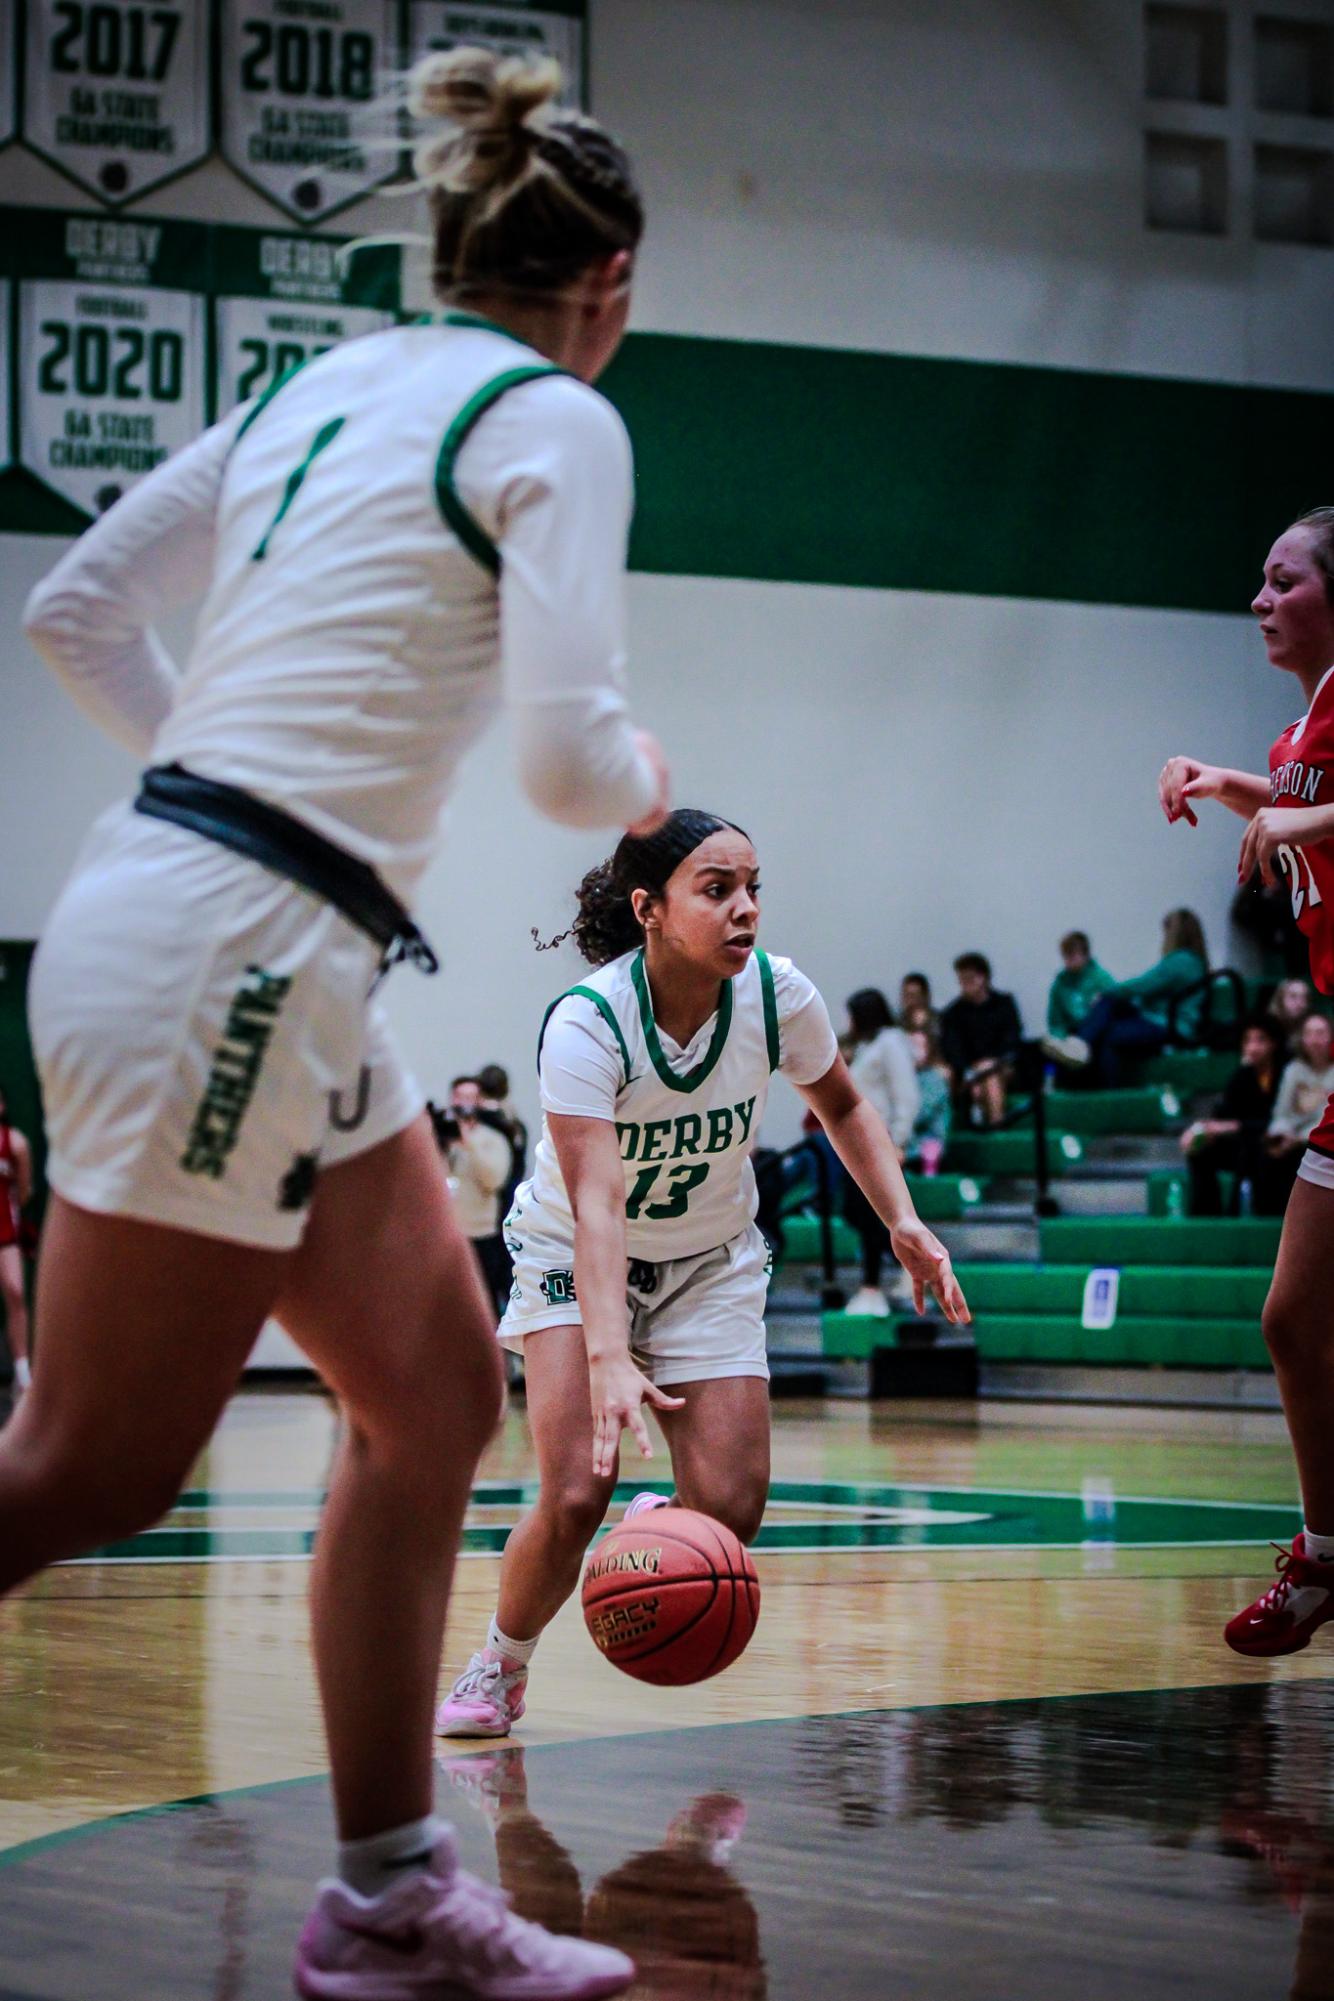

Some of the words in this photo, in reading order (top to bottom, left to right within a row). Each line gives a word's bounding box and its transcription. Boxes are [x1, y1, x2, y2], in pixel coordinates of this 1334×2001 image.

[52, 1, 181, 81] 2017
[241, 21, 373, 102] 2018
[101, 89, 159, 120] STATE
[56, 115, 174, 153] CHAMPIONS
[65, 219, 160, 265] DERBY
[38, 320, 182, 401] 2020
[98, 412, 154, 442] STATE
[615, 1096, 757, 1162] DERBY
[625, 1162, 710, 1220] 13
[586, 1548, 662, 1583] ALDING
